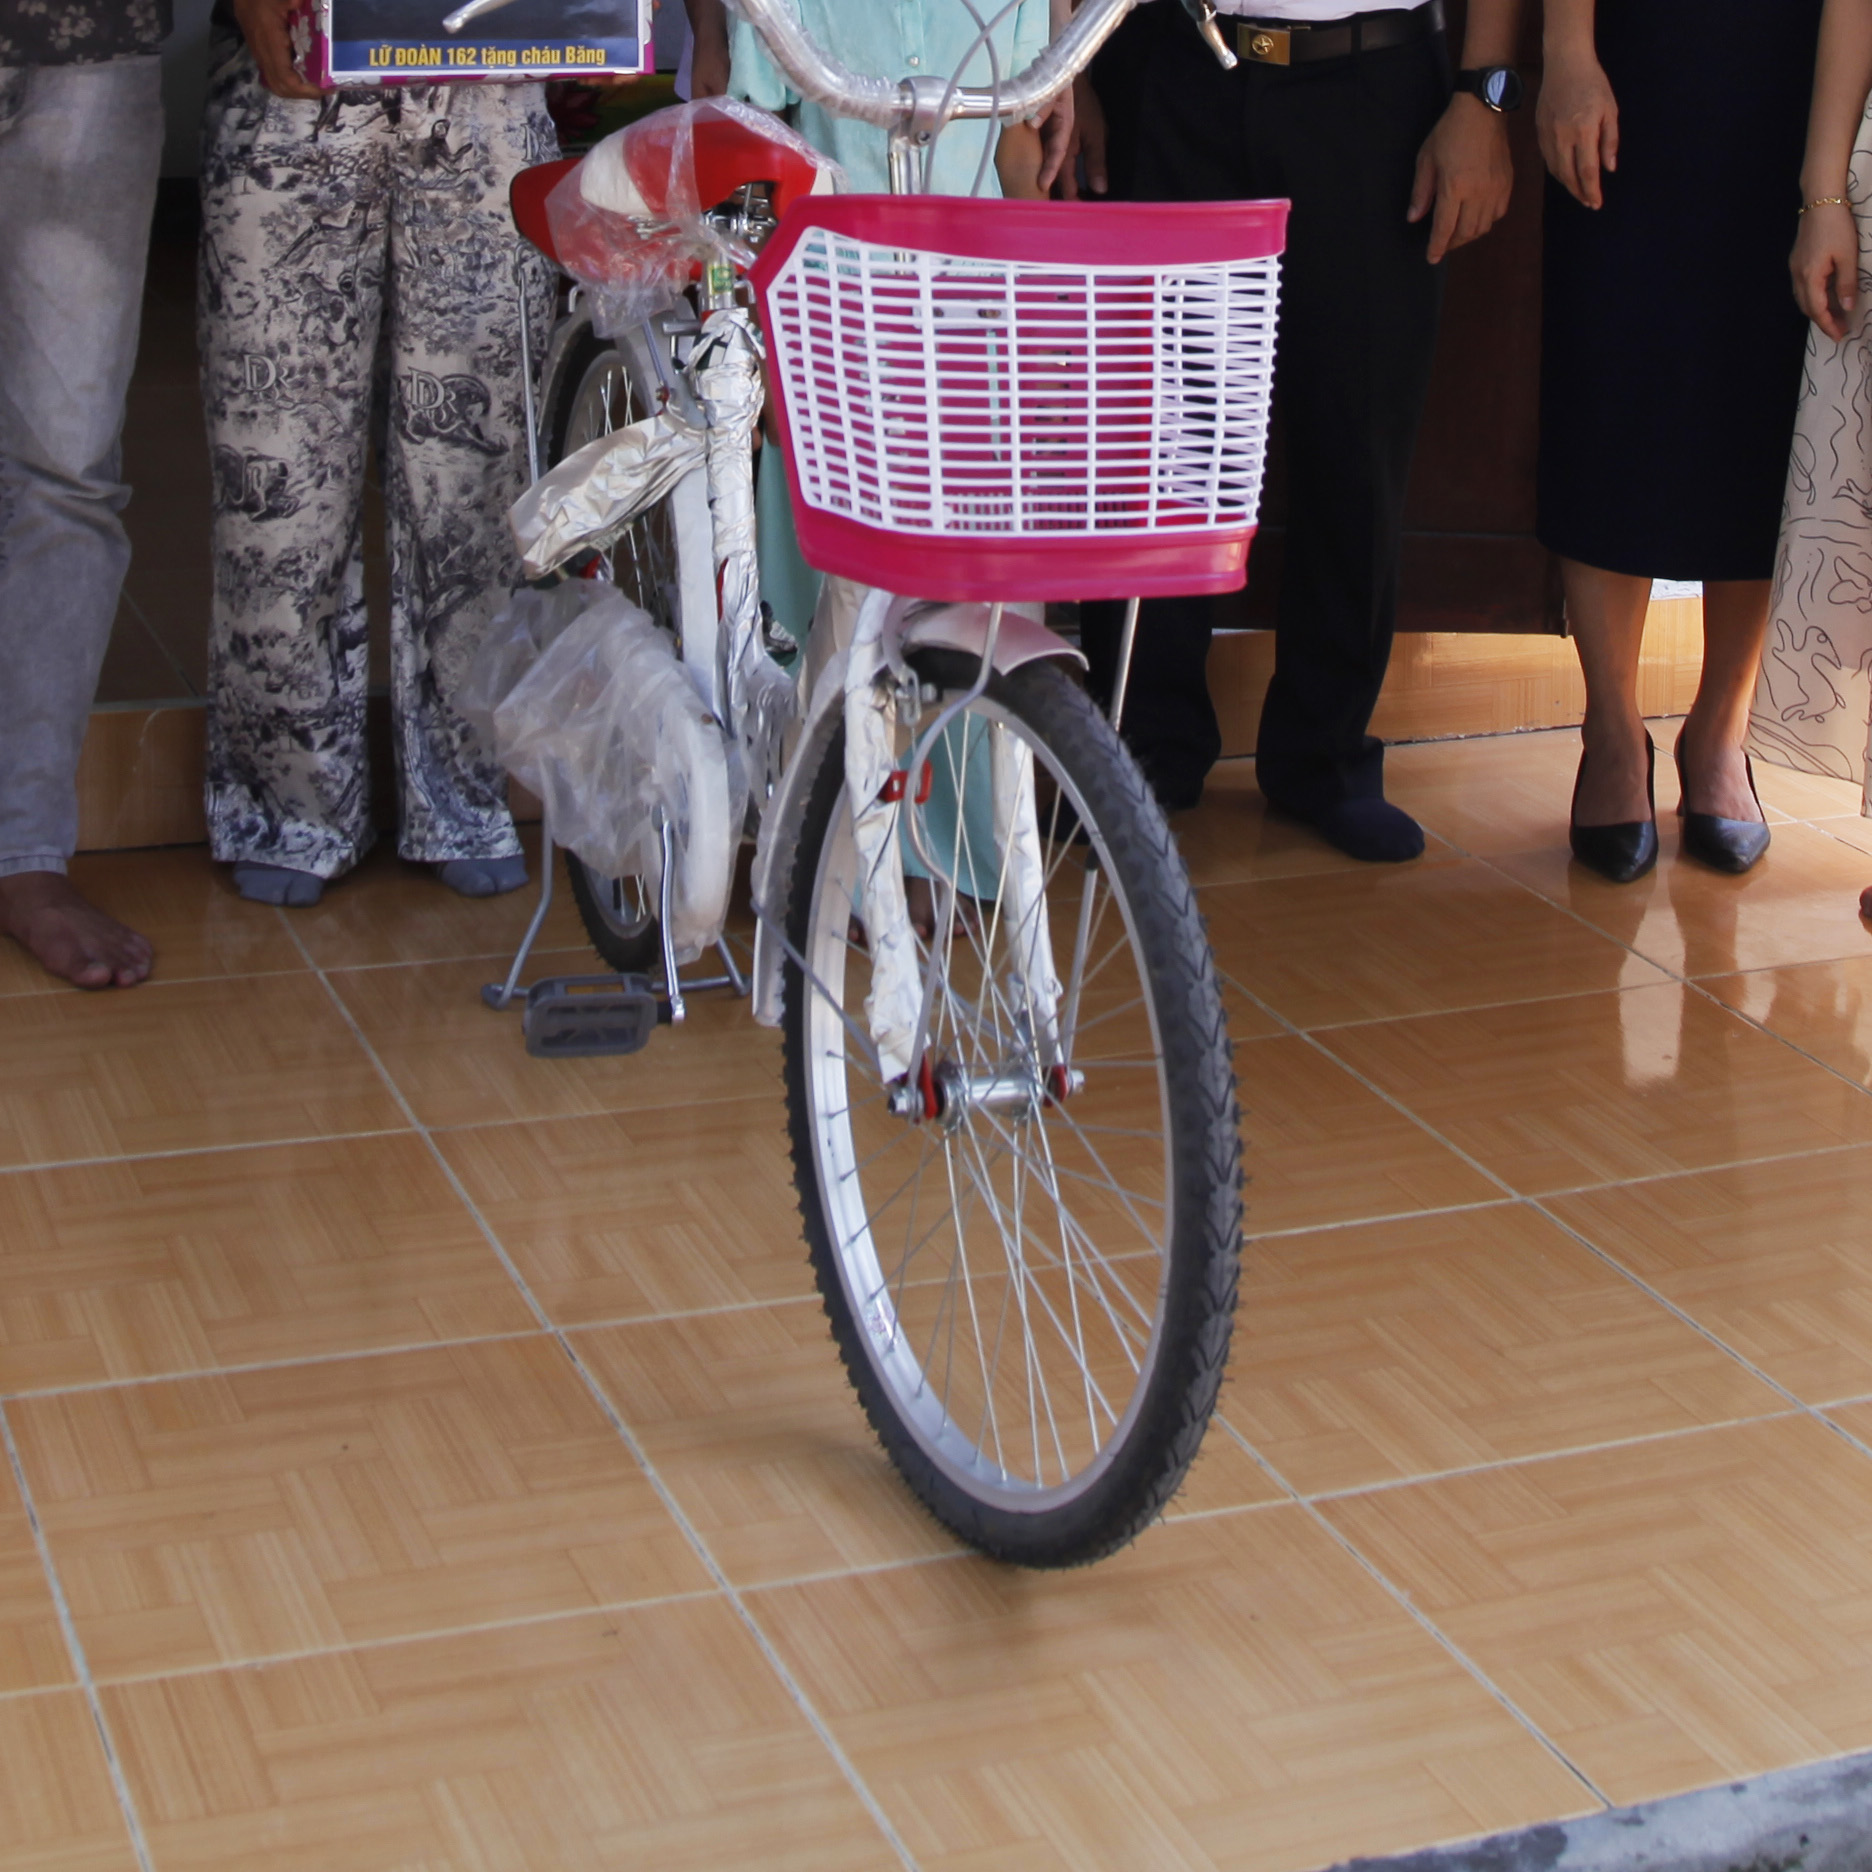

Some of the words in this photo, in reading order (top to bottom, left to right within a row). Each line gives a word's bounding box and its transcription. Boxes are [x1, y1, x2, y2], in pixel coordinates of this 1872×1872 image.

[369, 44, 392, 67] LỮ
[395, 44, 442, 67] ĐOÀN
[447, 47, 477, 66] 162
[481, 46, 517, 69] tặng
[522, 46, 561, 66] cháu
[565, 44, 606, 66] Băng
